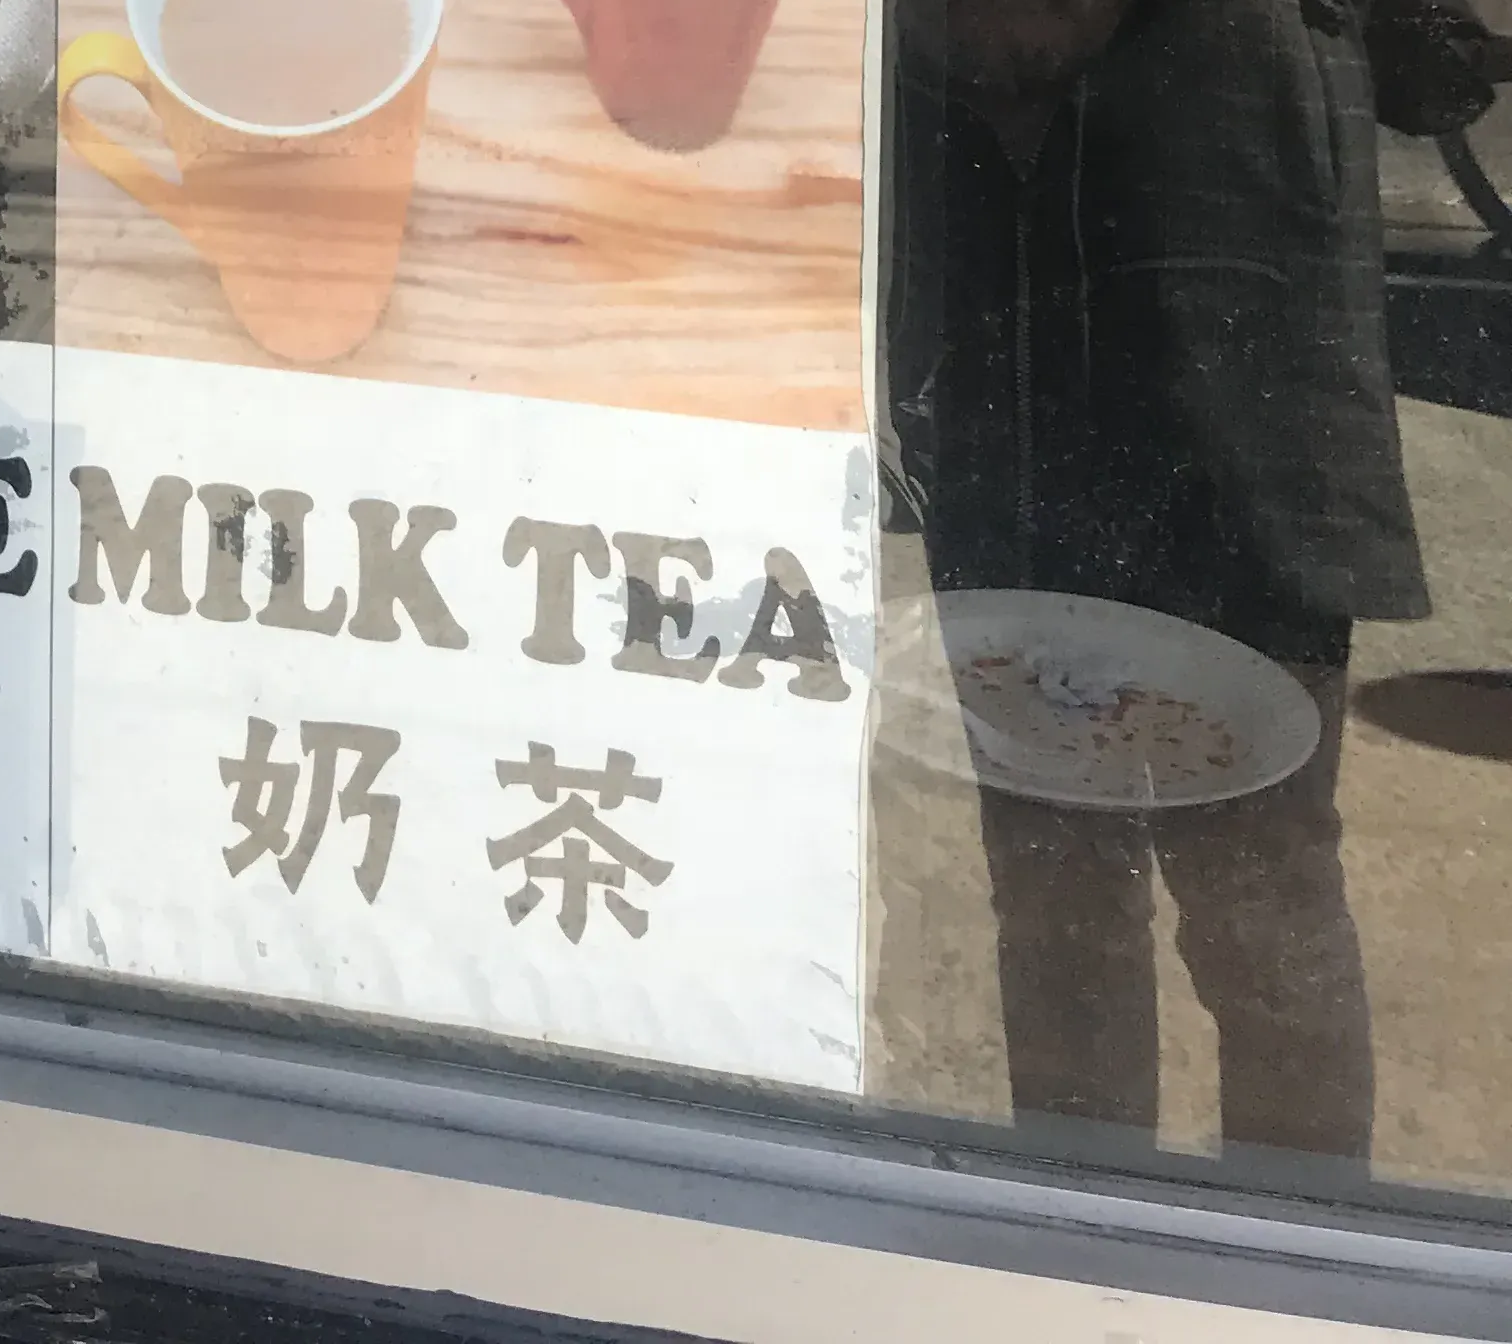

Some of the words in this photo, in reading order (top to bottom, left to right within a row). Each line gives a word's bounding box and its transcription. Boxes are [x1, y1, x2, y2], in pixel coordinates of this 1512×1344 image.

[70, 466, 470, 651] MILK
[503, 517, 852, 702] TEA
[219, 715, 674, 945] 奶茶
